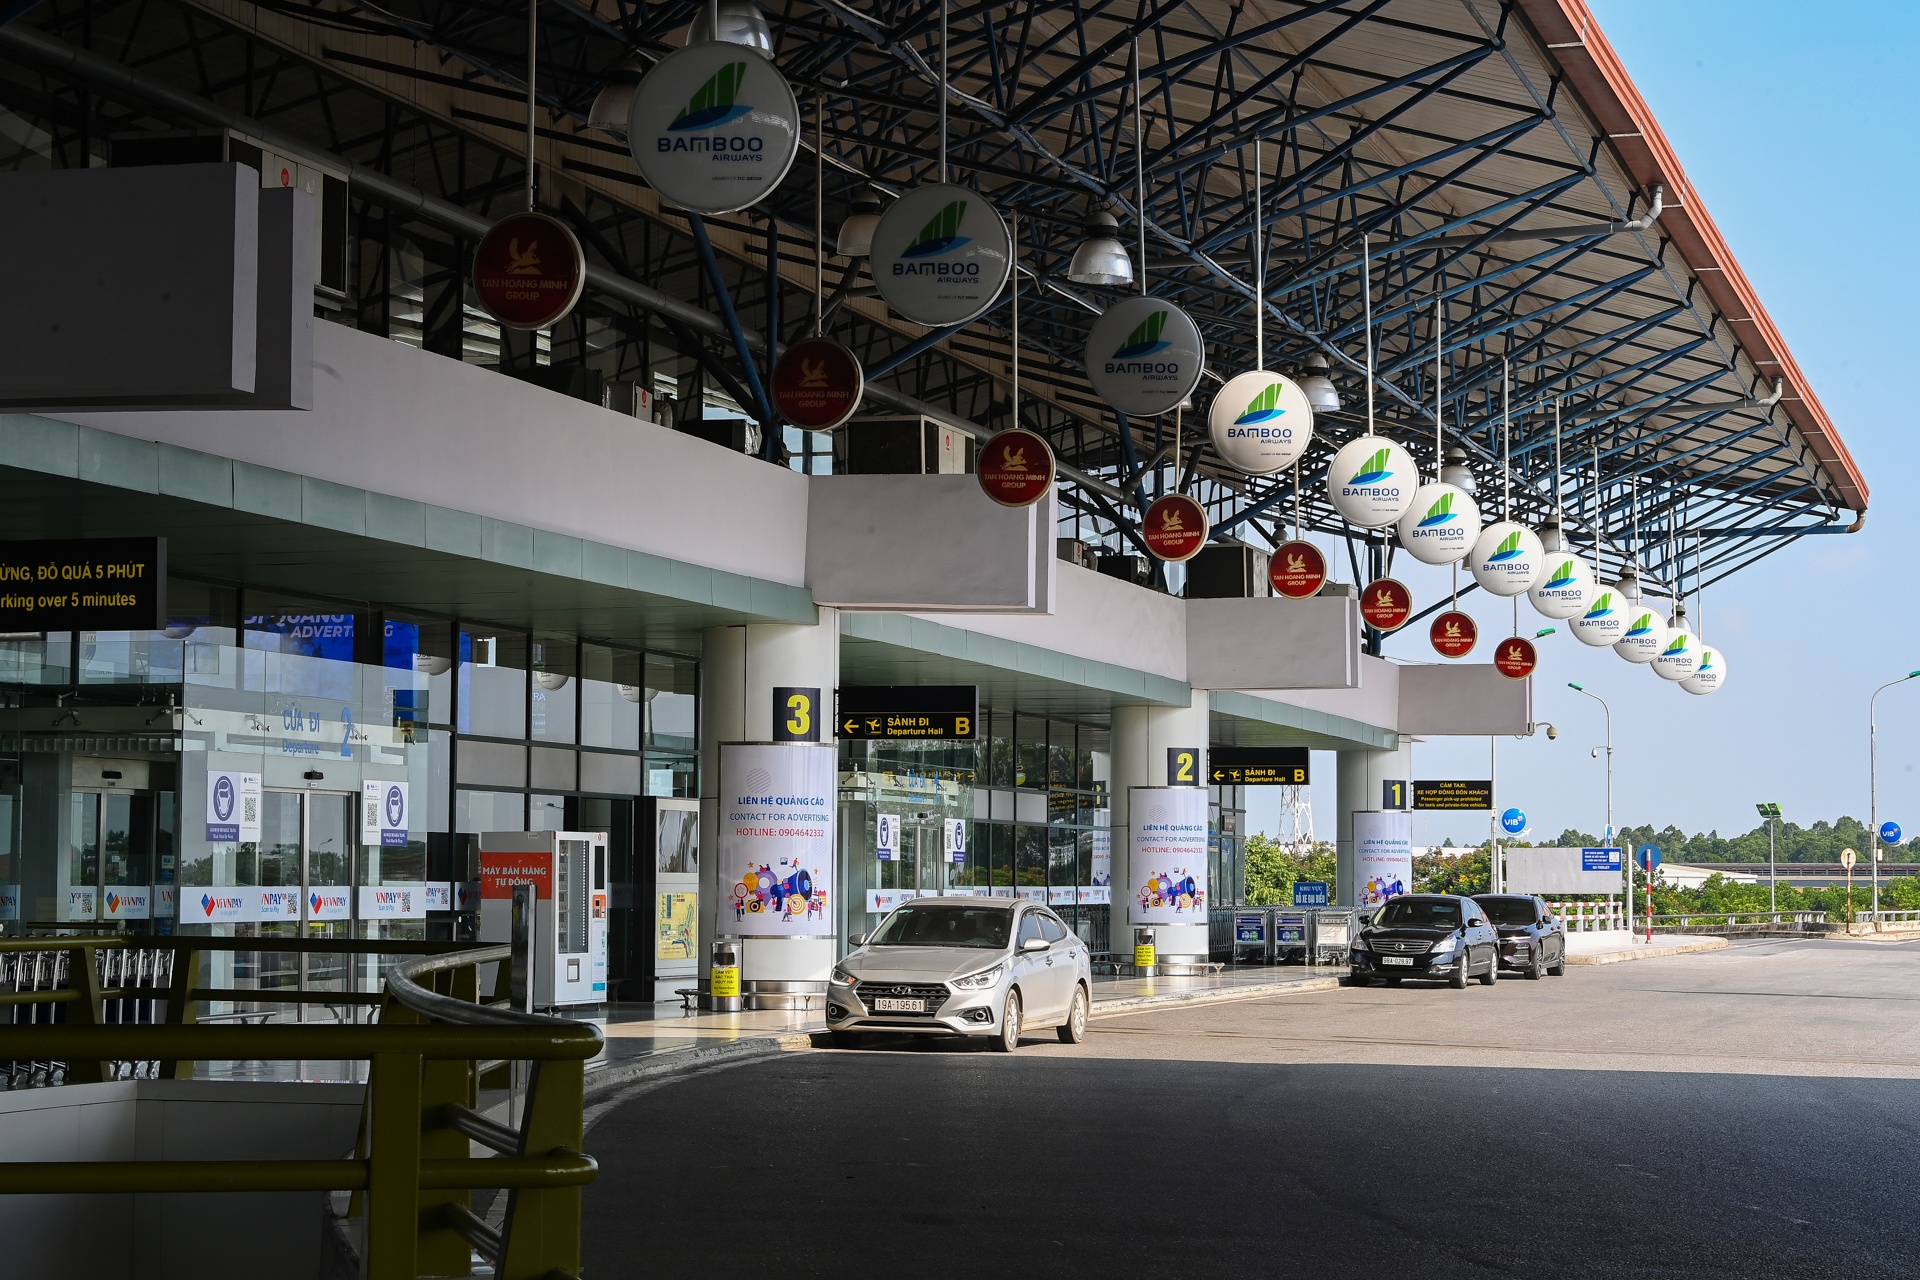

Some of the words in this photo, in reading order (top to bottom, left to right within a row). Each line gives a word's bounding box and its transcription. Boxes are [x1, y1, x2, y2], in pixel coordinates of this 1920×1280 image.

[657, 137, 763, 153] BAMBOO
[893, 263, 980, 276] BAMBOO
[481, 278, 500, 289] TAN
[501, 279, 537, 290] HOANG
[539, 279, 567, 290] MINH
[505, 290, 540, 301] GROUP
[1105, 363, 1179, 374] BAMBOO
[778, 390, 794, 399] TAN
[794, 390, 826, 399] HOANG
[826, 390, 850, 399] MINH
[798, 399, 827, 408] GROUP
[1227, 428, 1292, 439] BAMBOO
[1342, 488, 1400, 497] BAMBOO
[1160, 532, 1182, 540] HOANG
[1412, 528, 1464, 537] BAMBOO
[1163, 538, 1184, 546] GROUP
[0, 562, 34, 583] ỪNG,
[37, 561, 58, 580] ĐỖ
[61, 561, 92, 580] QUÁ
[95, 564, 104, 579] 5
[107, 560, 145, 579] PHÚT
[1483, 563, 1530, 572] BAMBOO
[37, 594, 68, 608] over
[71, 592, 79, 607] 5
[82, 591, 137, 607] minutes
[1538, 590, 1582, 598] BAMBOO
[290, 625, 394, 638] ADVERTG
[1620, 637, 1657, 645] BAMBOO
[787, 694, 811, 735] 3
[887, 715, 916, 726] SẢNH
[918, 717, 929, 726] ĐI
[955, 717, 970, 735] B
[341, 706, 352, 757] 2
[887, 728, 925, 737] Departure
[927, 727, 943, 735] Hall
[282, 738, 320, 757] Departure
[1176, 753, 1194, 782] 2
[1244, 767, 1266, 776] SẢNH
[1294, 769, 1305, 782] B
[1391, 783, 1401, 806] 1
[738, 796, 759, 806] LIÊN
[760, 795, 773, 807] HỆ
[775, 794, 809, 806] QUẢNG
[810, 796, 825, 806] CÁO
[729, 812, 766, 822] CONTACT
[768, 812, 786, 822] FOR
[787, 812, 829, 822] ADVERTISING
[736, 828, 777, 837] HOTLINE:
[778, 828, 825, 837] 0904642332
[1143, 823, 1158, 831] LIÊN
[1159, 823, 1169, 833] HỆ
[1170, 823, 1193, 832] QUẢNG
[482, 865, 501, 875] MÁY
[502, 865, 520, 875] BÁN
[522, 865, 547, 875] HÀNG
[126, 896, 147, 906] VNPAY
[223, 897, 243, 909] VNPAY
[329, 896, 347, 907] VNPAY
